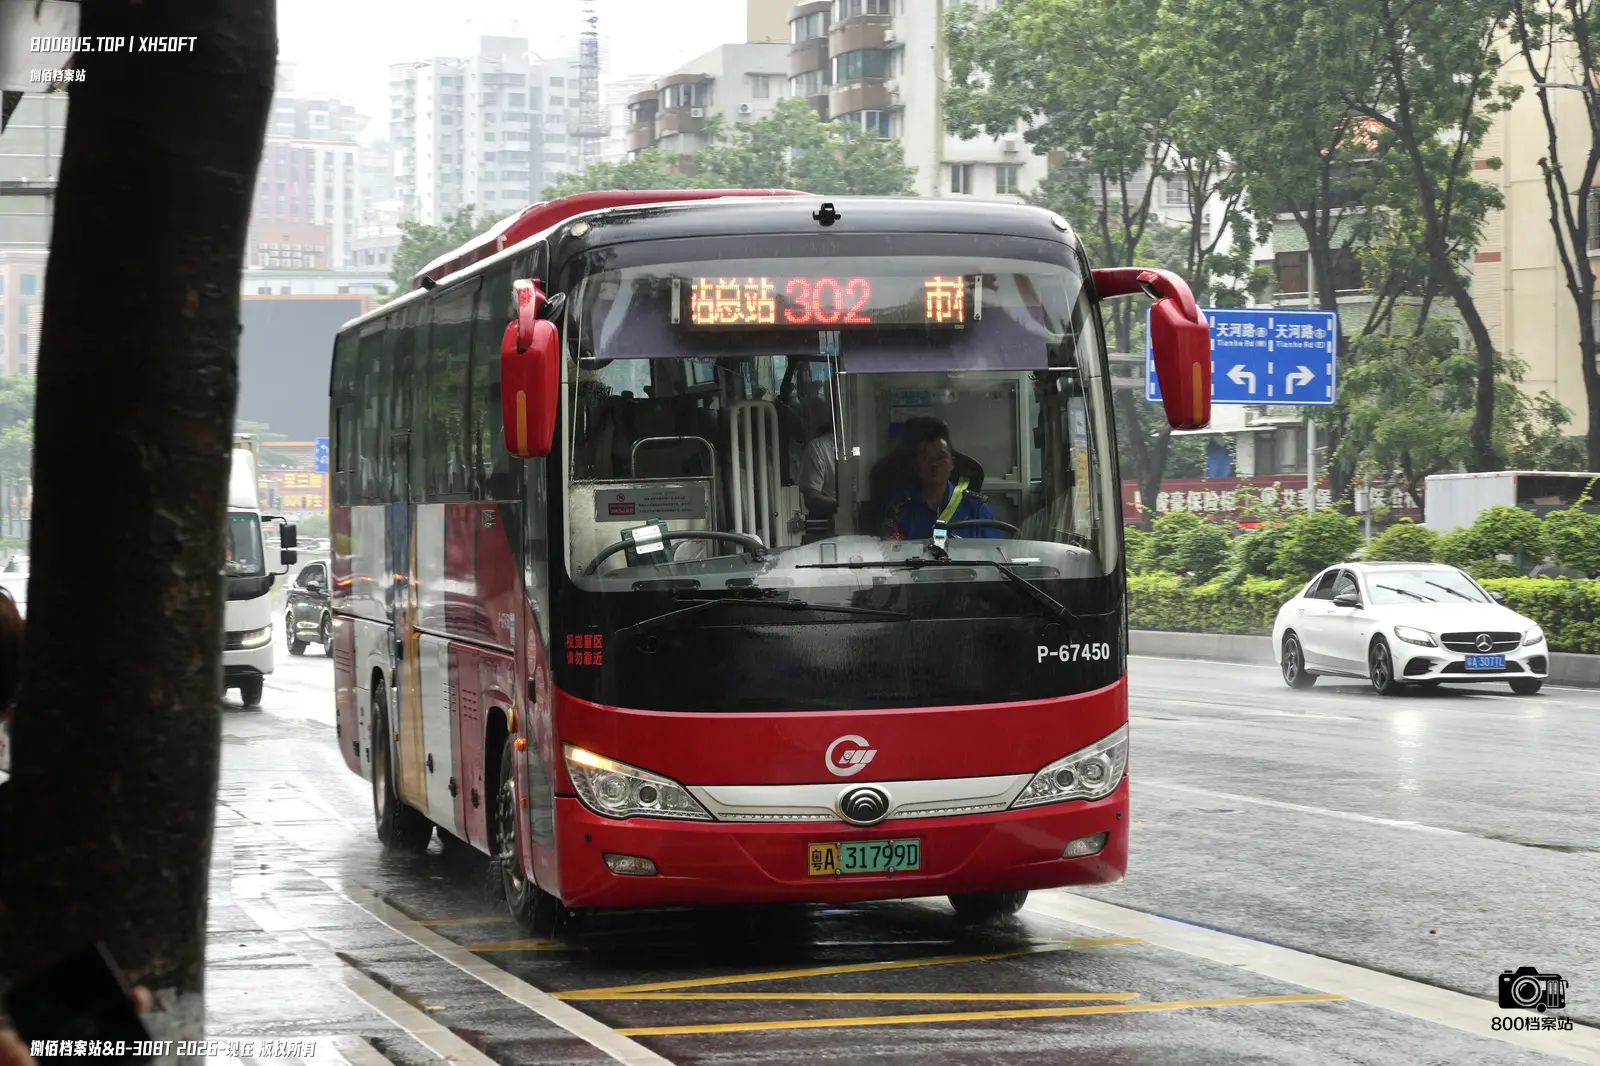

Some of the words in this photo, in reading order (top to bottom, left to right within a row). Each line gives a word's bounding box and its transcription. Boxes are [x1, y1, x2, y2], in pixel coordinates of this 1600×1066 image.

[784, 277, 873, 324] 302
[1244, 339, 1254, 347] Rd
[1303, 341, 1314, 349] Rd
[566, 633, 604, 649] 视觉盲区
[566, 650, 604, 666] 请勿靠近
[1036, 642, 1110, 664] P-67450
[811, 847, 835, 870] 粤A
[845, 844, 918, 870] 31799D
